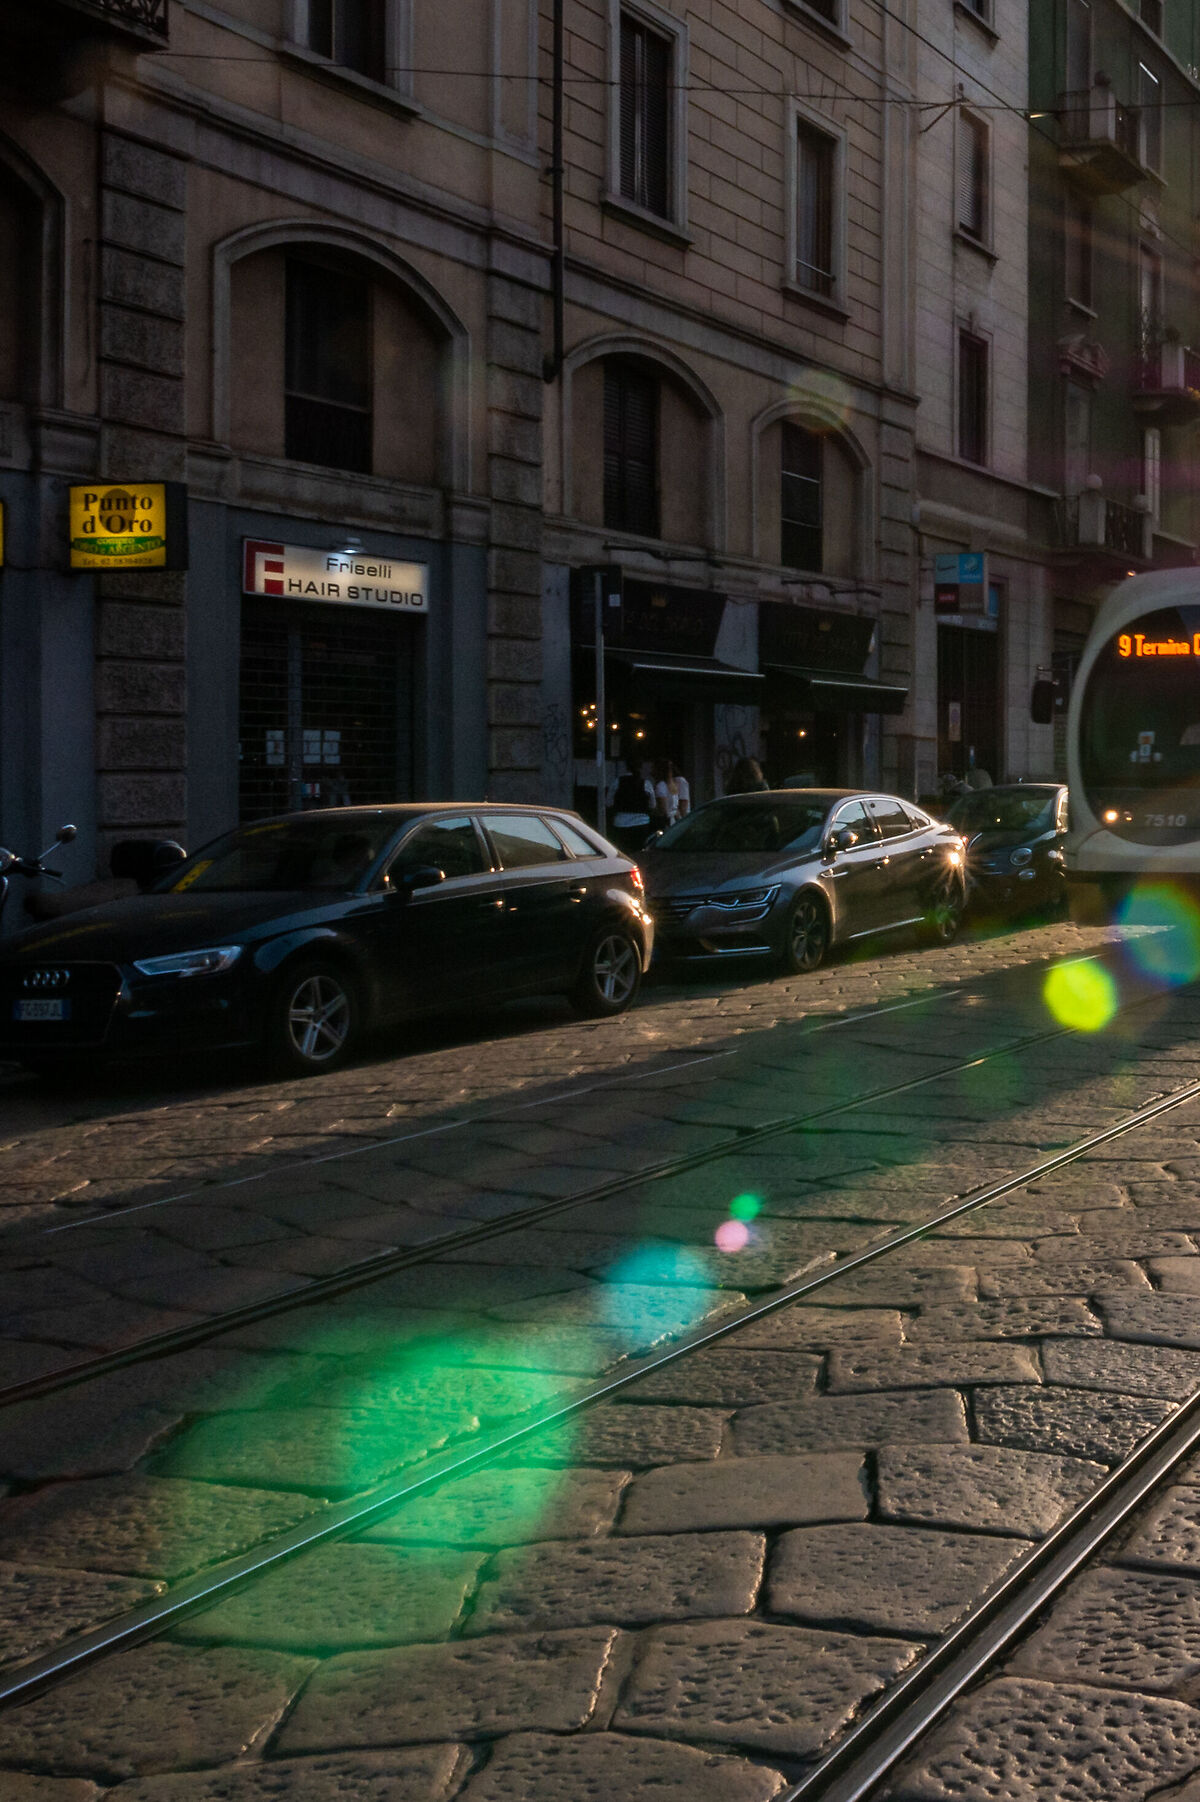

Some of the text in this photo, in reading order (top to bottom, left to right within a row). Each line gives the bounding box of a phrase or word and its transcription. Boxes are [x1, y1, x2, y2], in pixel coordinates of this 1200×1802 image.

[83, 492, 153, 512] Punto
[83, 515, 153, 534] d'Oro
[326, 557, 392, 579] Friselli
[288, 578, 423, 606] HAIR STUDIO
[1118, 634, 1132, 657] 9
[1144, 813, 1187, 827] 7510
